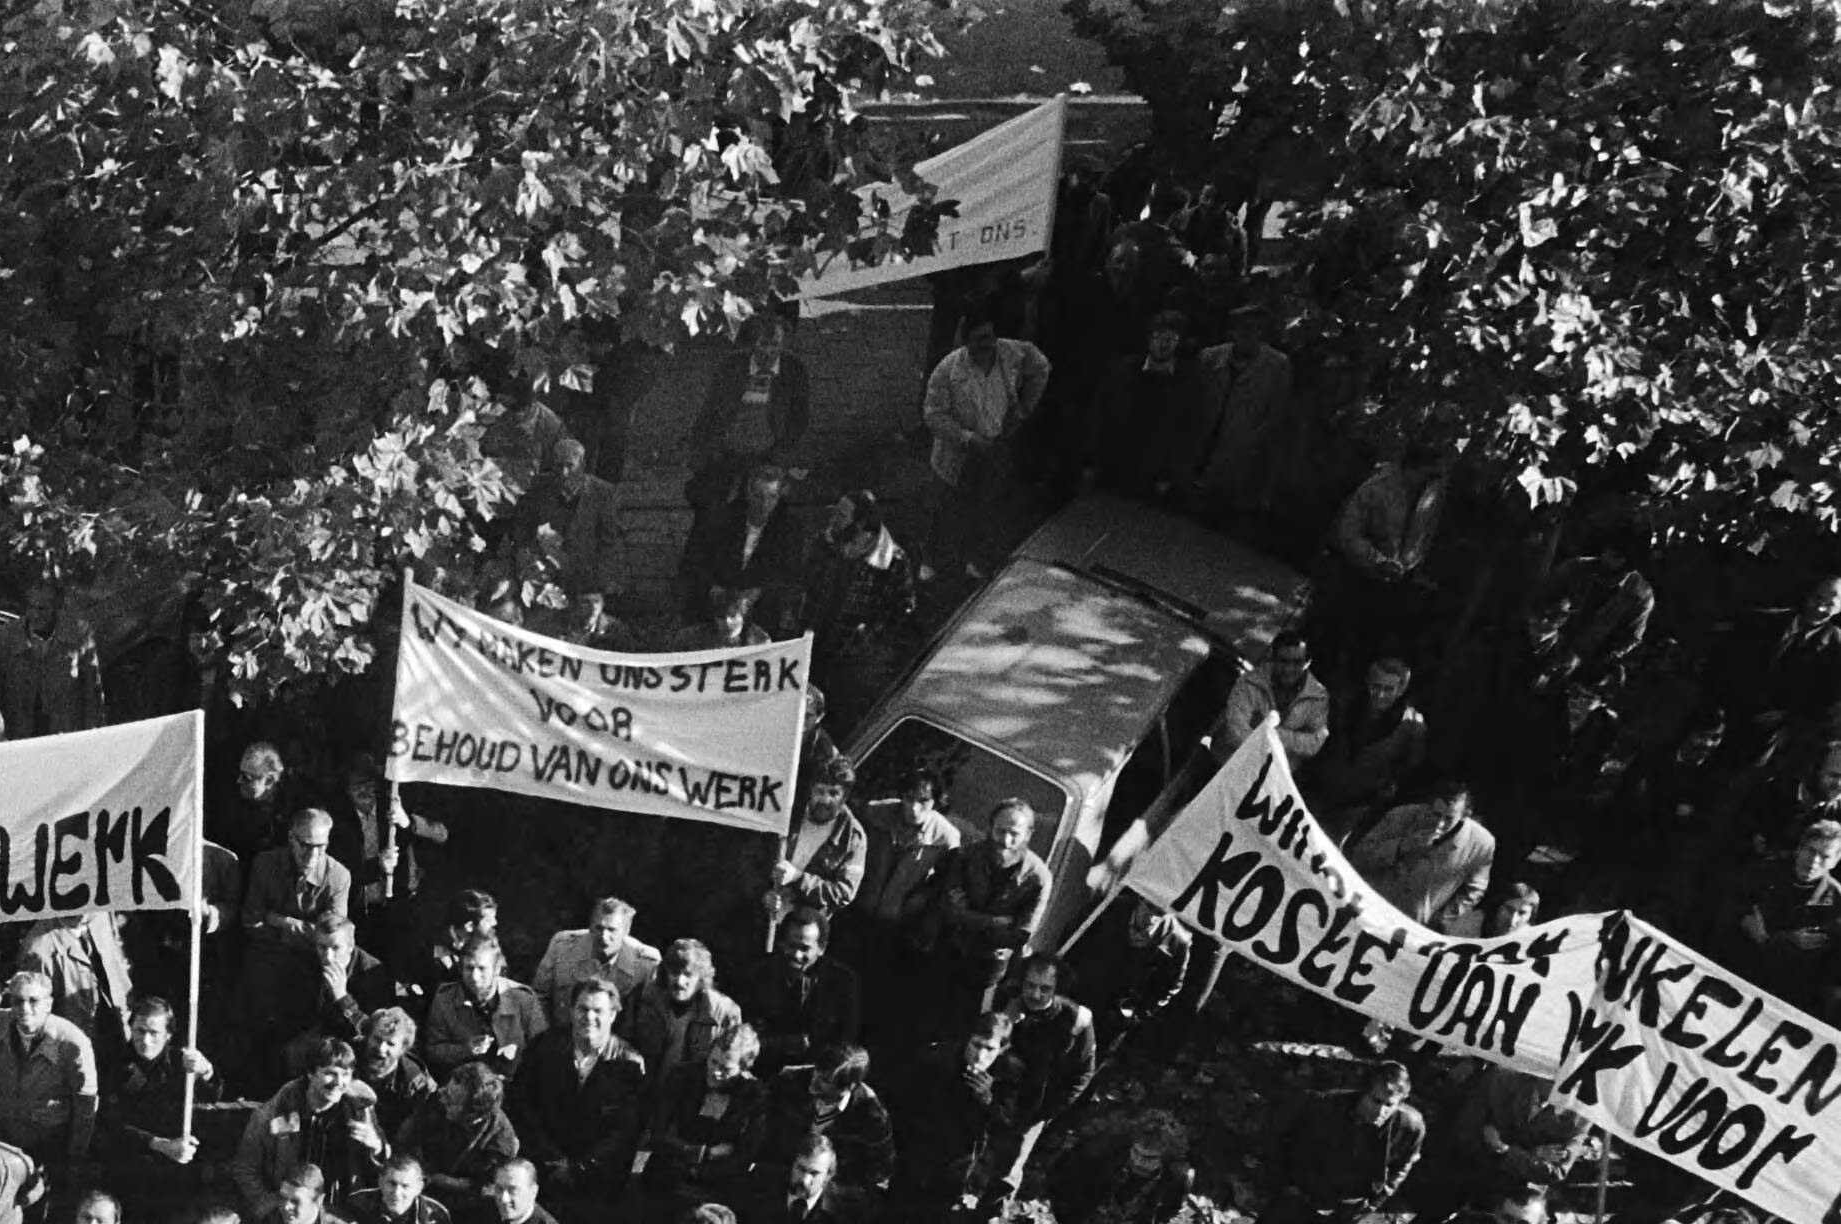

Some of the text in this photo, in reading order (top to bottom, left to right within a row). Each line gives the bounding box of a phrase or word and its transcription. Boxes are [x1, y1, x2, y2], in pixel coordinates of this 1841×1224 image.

[670, 657, 800, 693] STERK
[529, 688, 633, 743] VOOR
[388, 719, 784, 813] BEHOUD VAN ONS WERK
